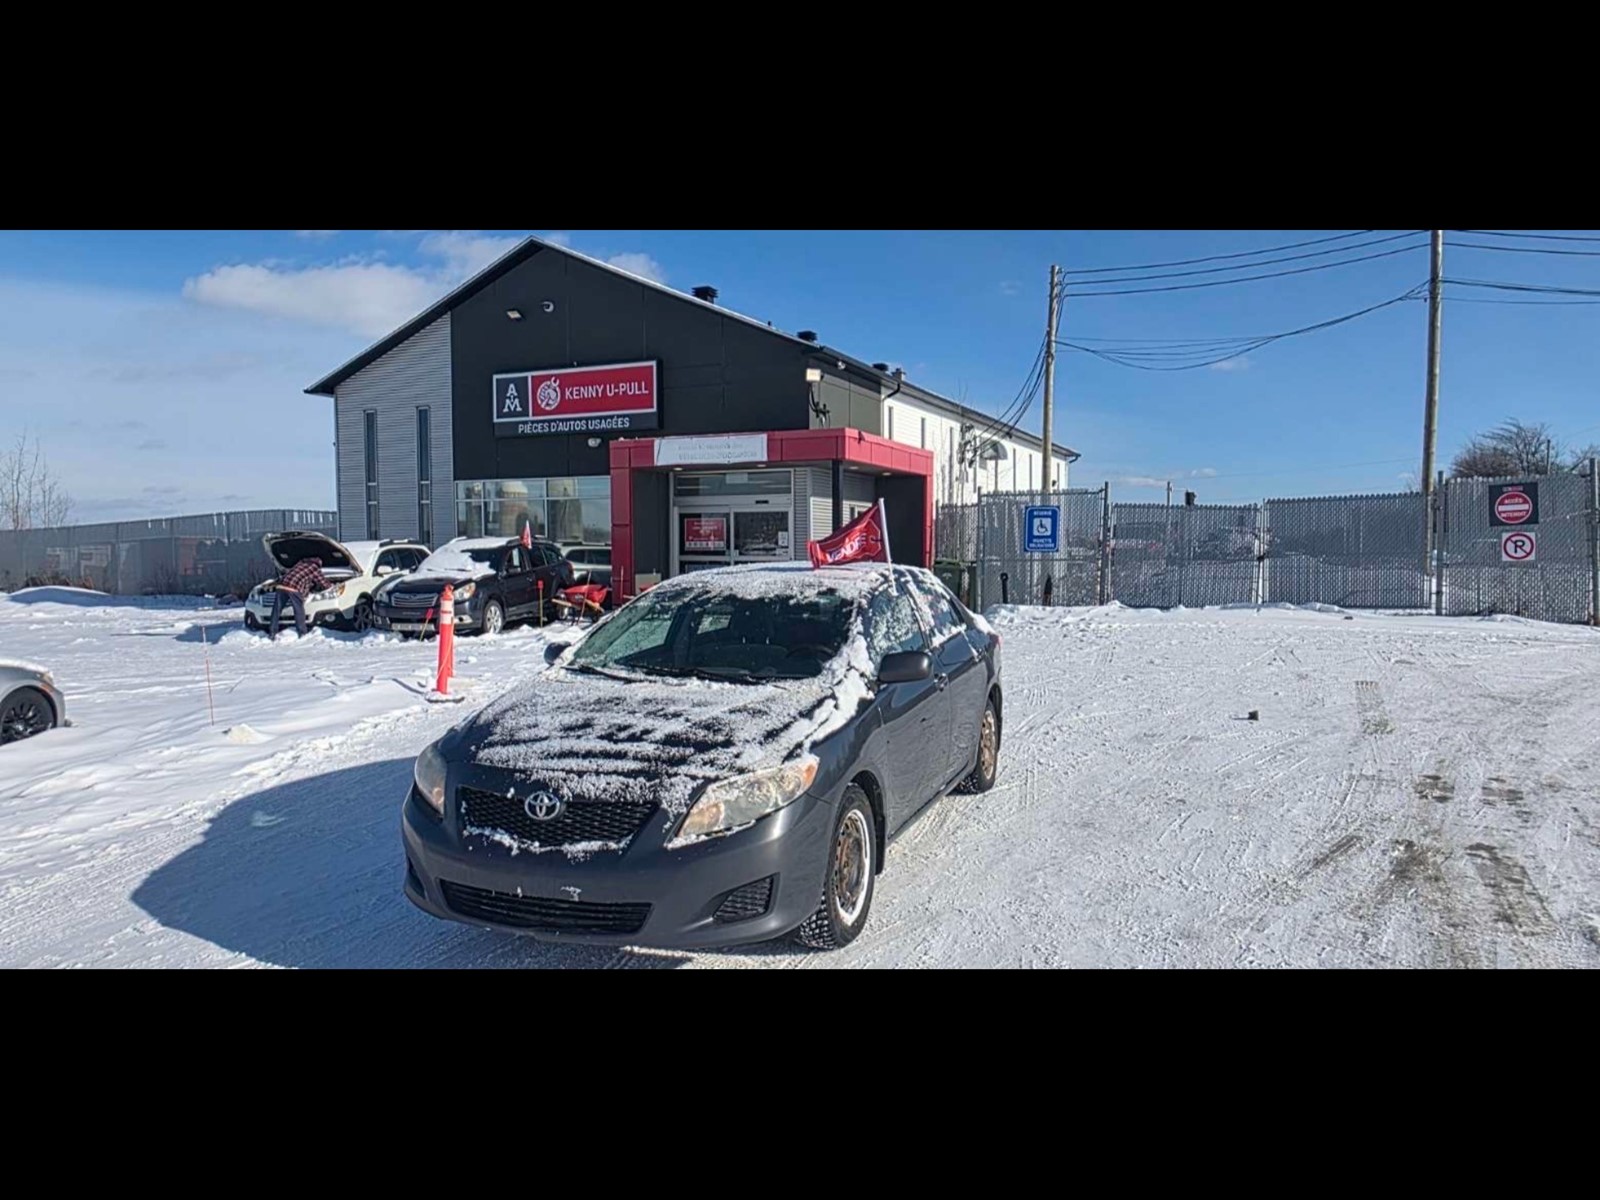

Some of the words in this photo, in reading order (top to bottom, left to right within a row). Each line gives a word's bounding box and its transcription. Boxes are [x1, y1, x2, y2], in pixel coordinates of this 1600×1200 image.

[565, 385, 604, 400] KENNY
[606, 381, 649, 396] U-PULL
[518, 421, 549, 434] PIÈCES
[550, 419, 587, 433] D'AUTOS
[588, 415, 630, 430] USAGÉES
